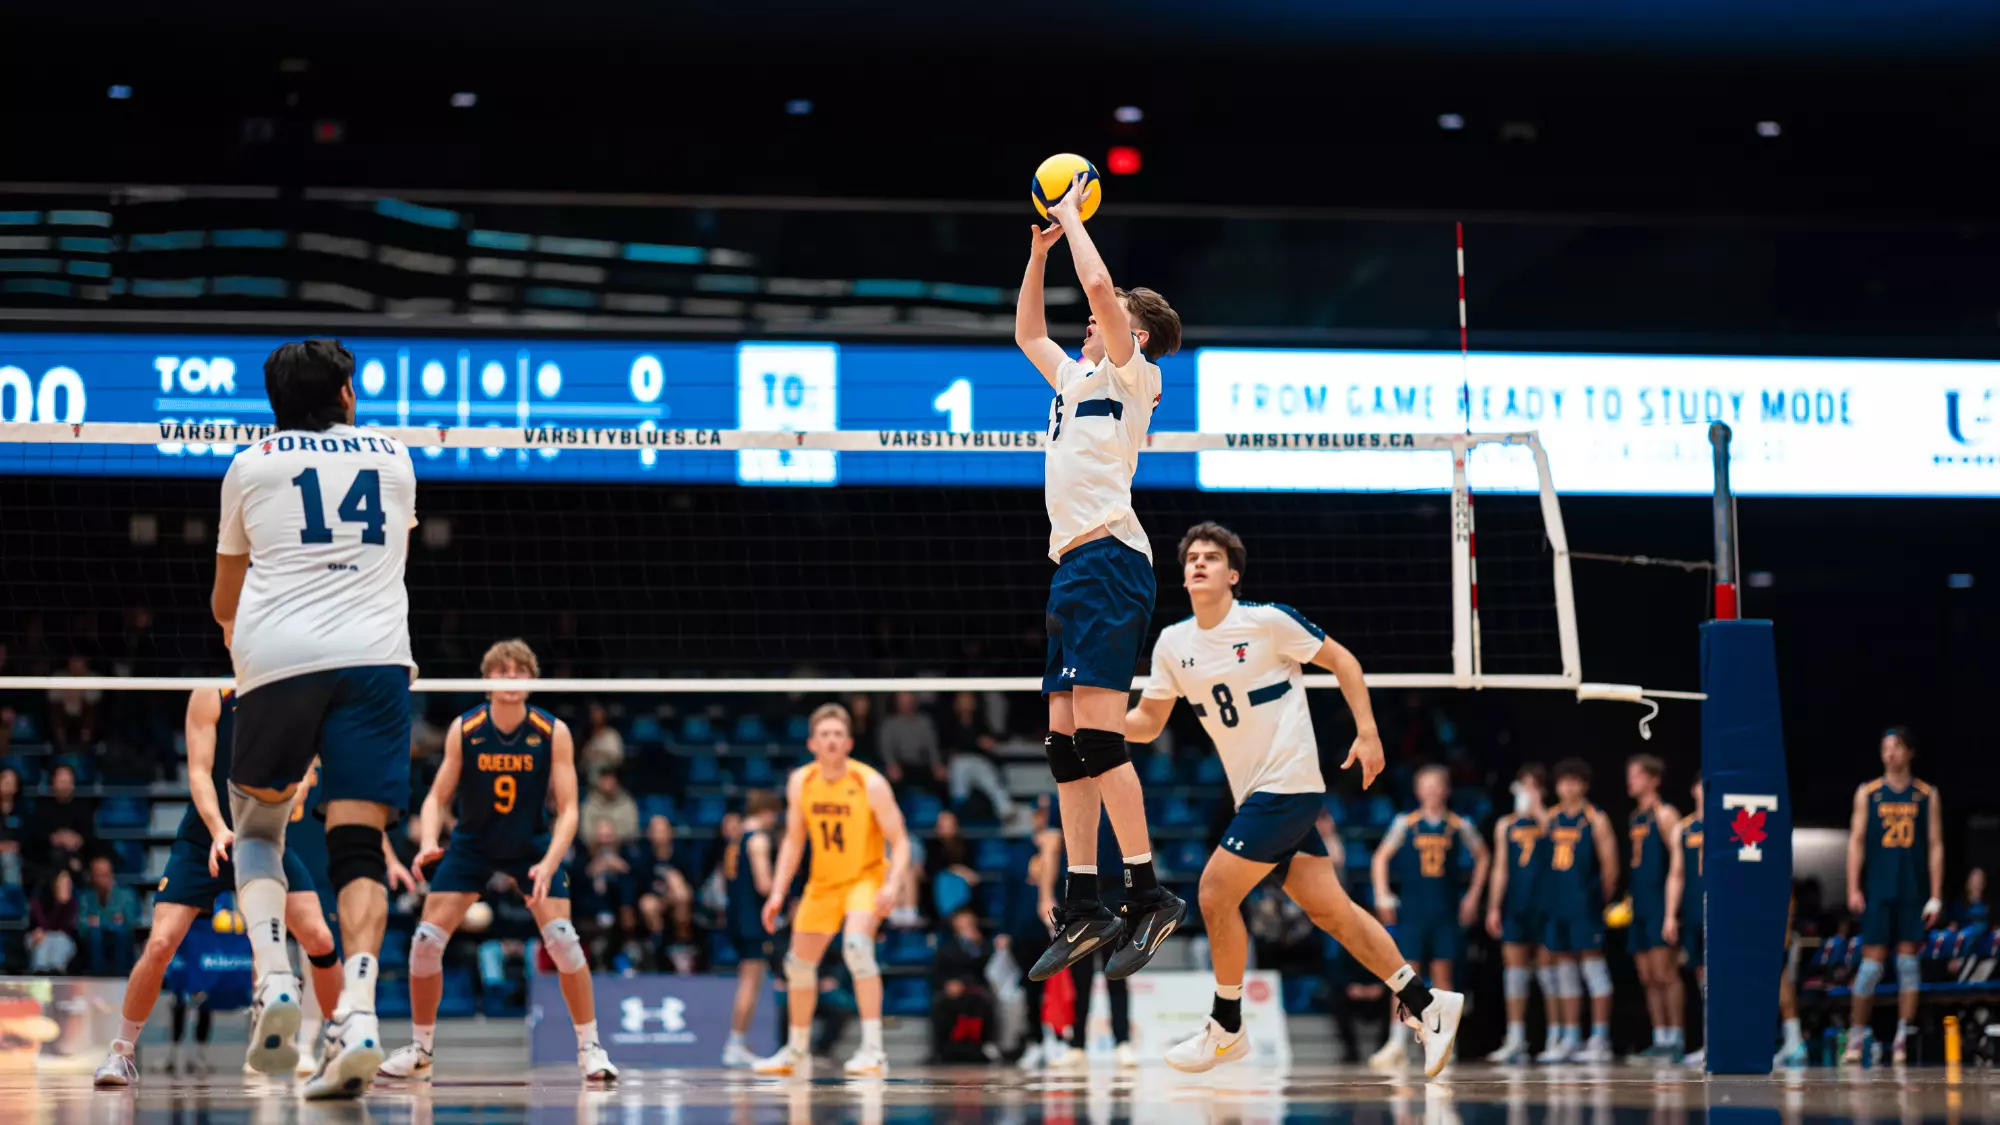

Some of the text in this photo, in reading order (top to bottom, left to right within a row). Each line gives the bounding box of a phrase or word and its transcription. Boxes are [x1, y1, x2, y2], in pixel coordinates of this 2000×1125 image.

[154, 356, 237, 394] TOR
[630, 355, 664, 402] 0
[932, 377, 974, 433] 1
[1637, 386, 1745, 424] STUDY
[523, 429, 722, 446] VARSITYBLUES.CA
[879, 431, 1045, 447] VARSITYBLUES.
[1225, 433, 1415, 448] VARSITYBLUES.CA
[292, 467, 386, 546] 14
[1211, 683, 1239, 728] 8
[478, 753, 533, 772] QUEEN'S
[494, 774, 517, 814] 9
[821, 820, 845, 854] 14
[1881, 817, 1915, 849] 20
